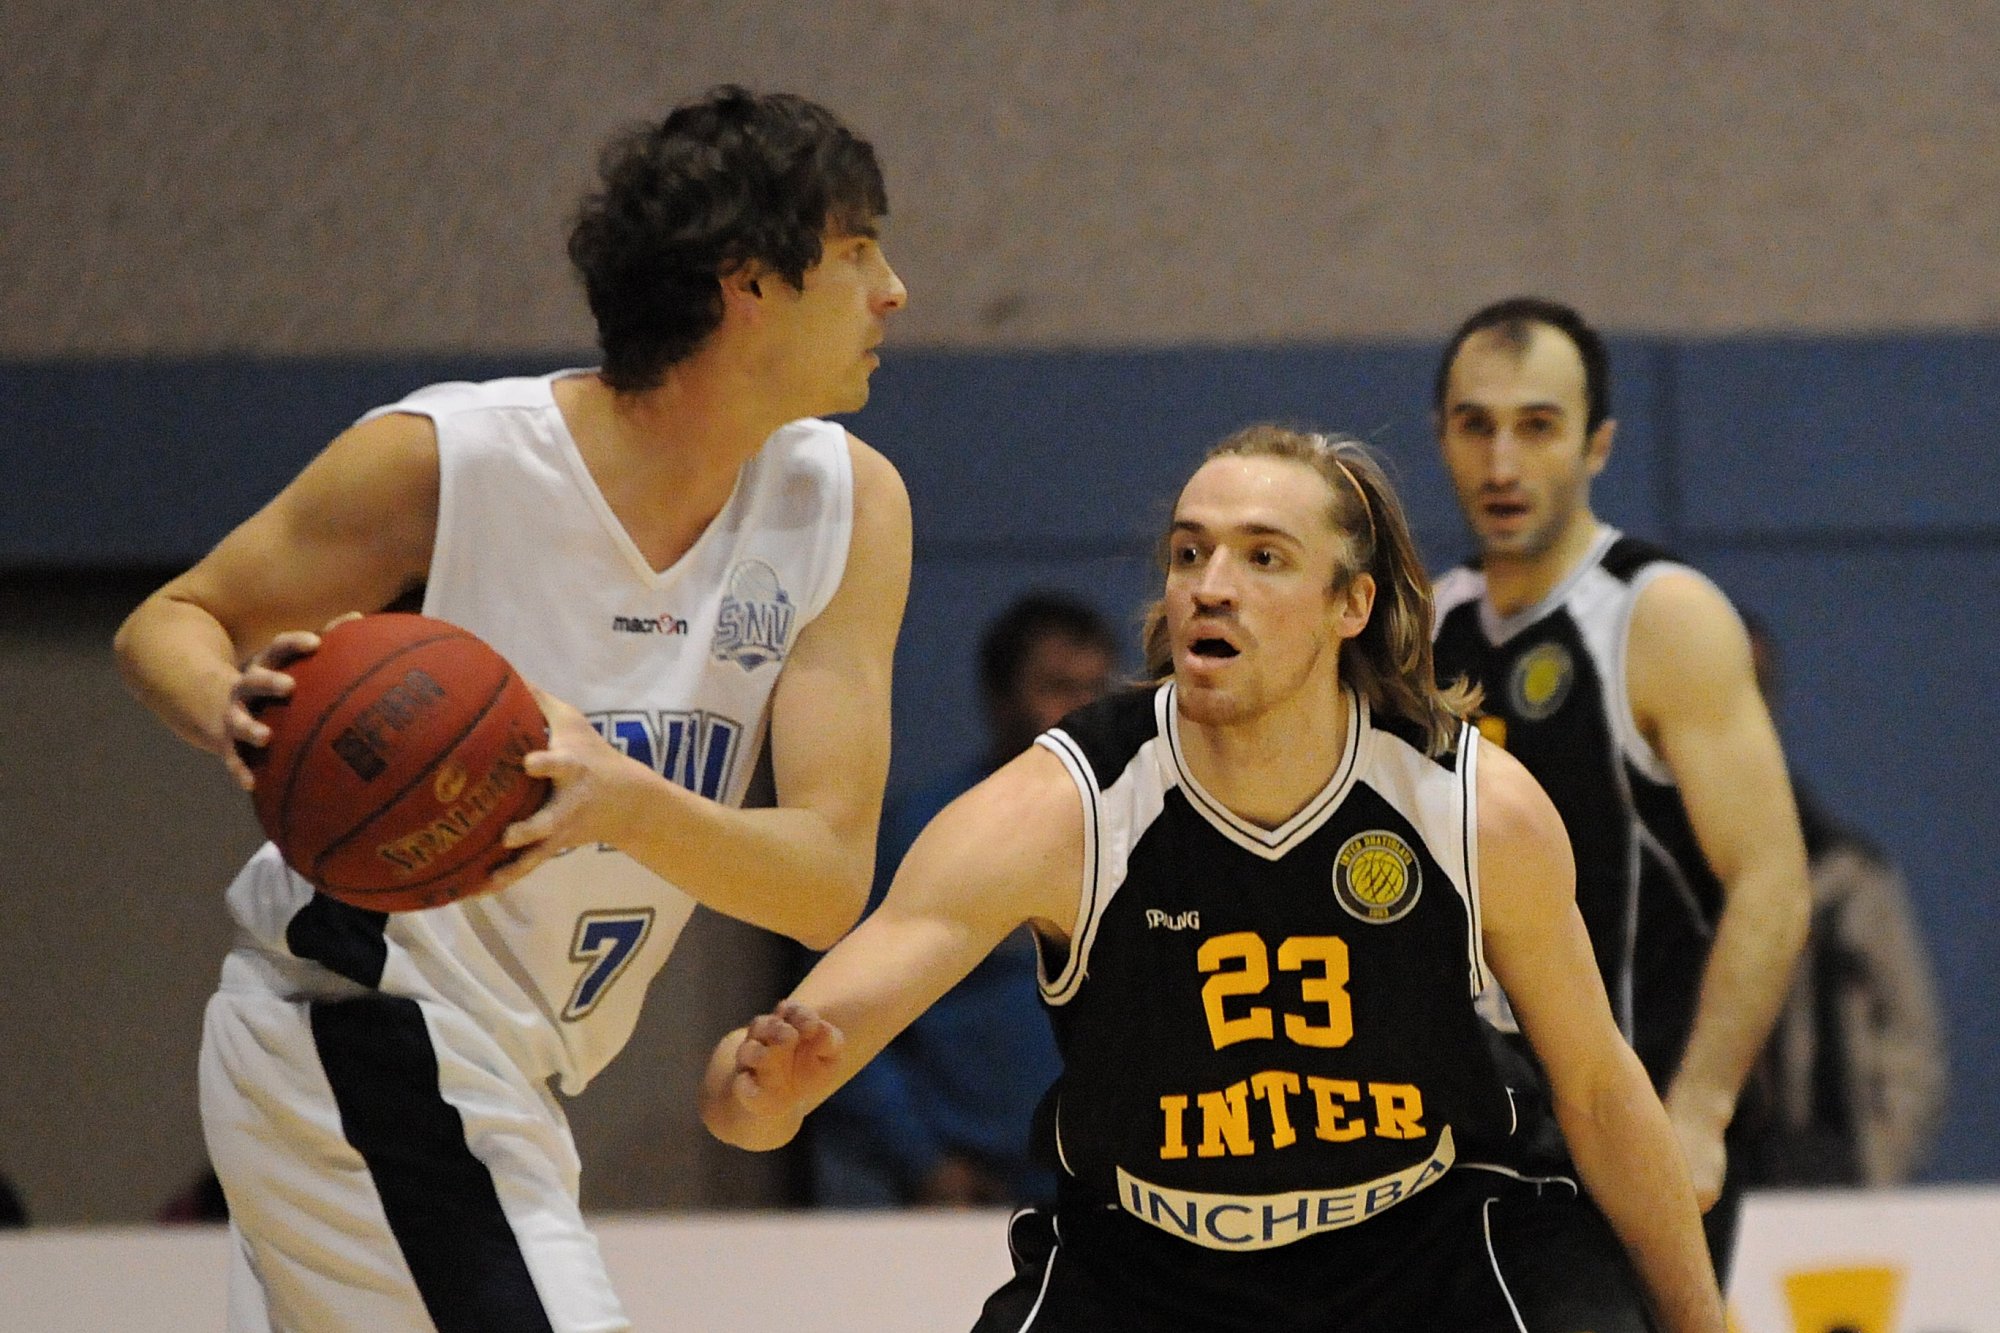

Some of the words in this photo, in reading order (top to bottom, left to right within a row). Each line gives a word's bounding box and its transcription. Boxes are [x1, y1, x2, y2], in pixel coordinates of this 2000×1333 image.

[613, 612, 688, 635] macron
[560, 907, 656, 1022] 7
[1197, 931, 1353, 1050] 23
[1160, 1070, 1426, 1160] INTER
[1130, 1159, 1446, 1243] INCHEBA
